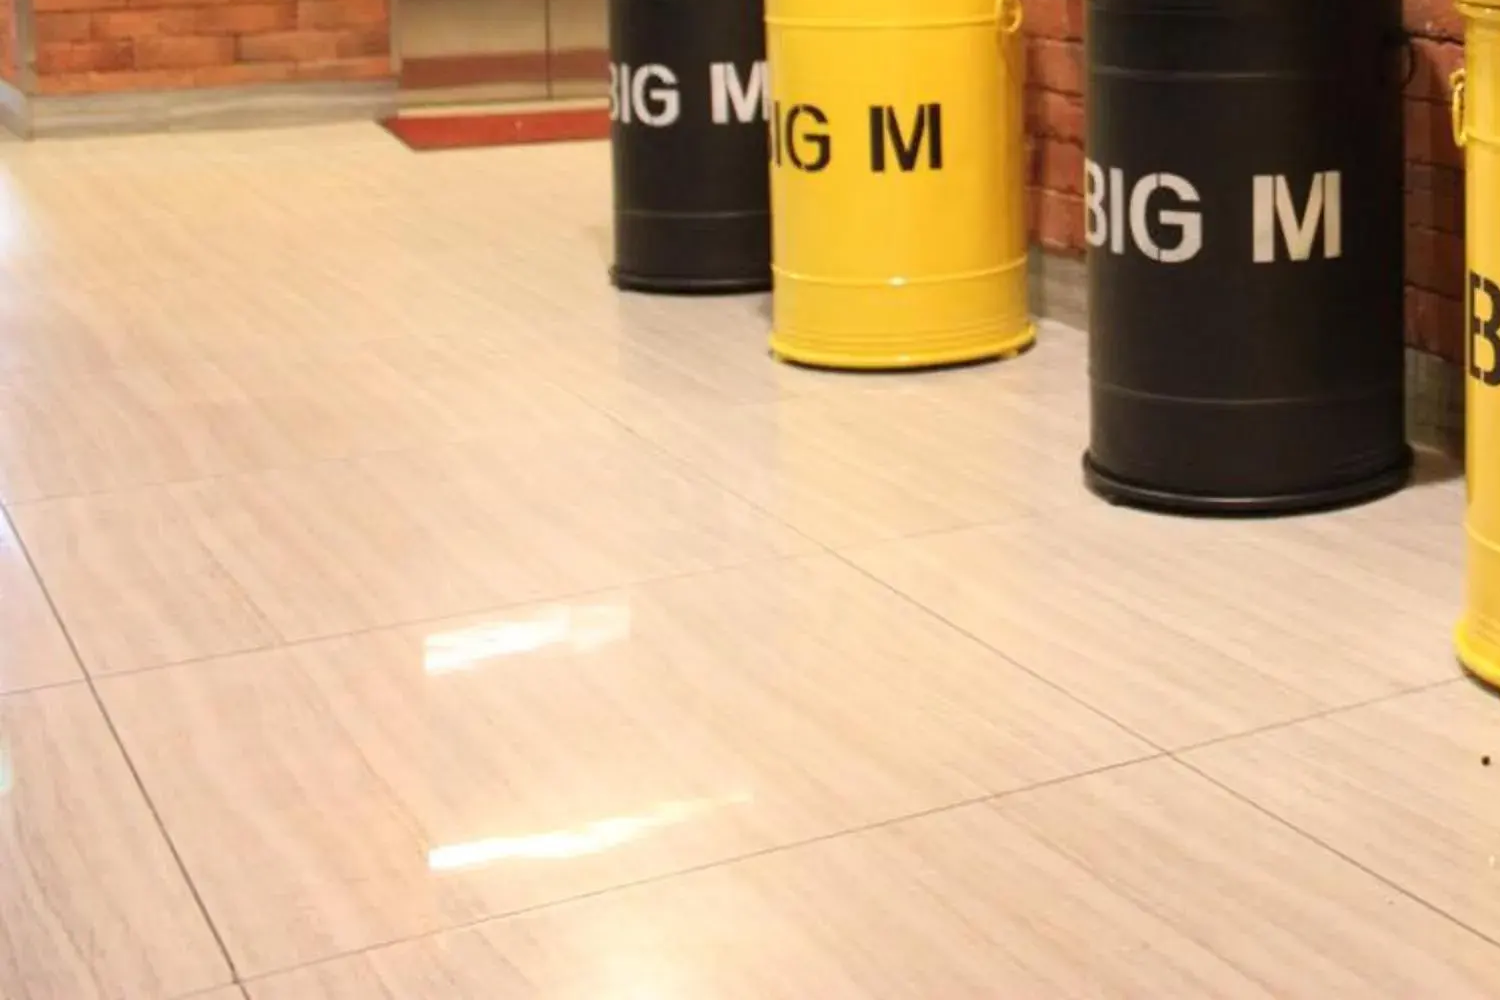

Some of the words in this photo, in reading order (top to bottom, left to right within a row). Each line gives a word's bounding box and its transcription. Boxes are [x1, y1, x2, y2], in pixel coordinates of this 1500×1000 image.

[709, 60, 769, 125] M
[770, 101, 831, 173] IG
[869, 103, 943, 173] M
[1085, 157, 1203, 263] BIG
[1252, 171, 1341, 263] M
